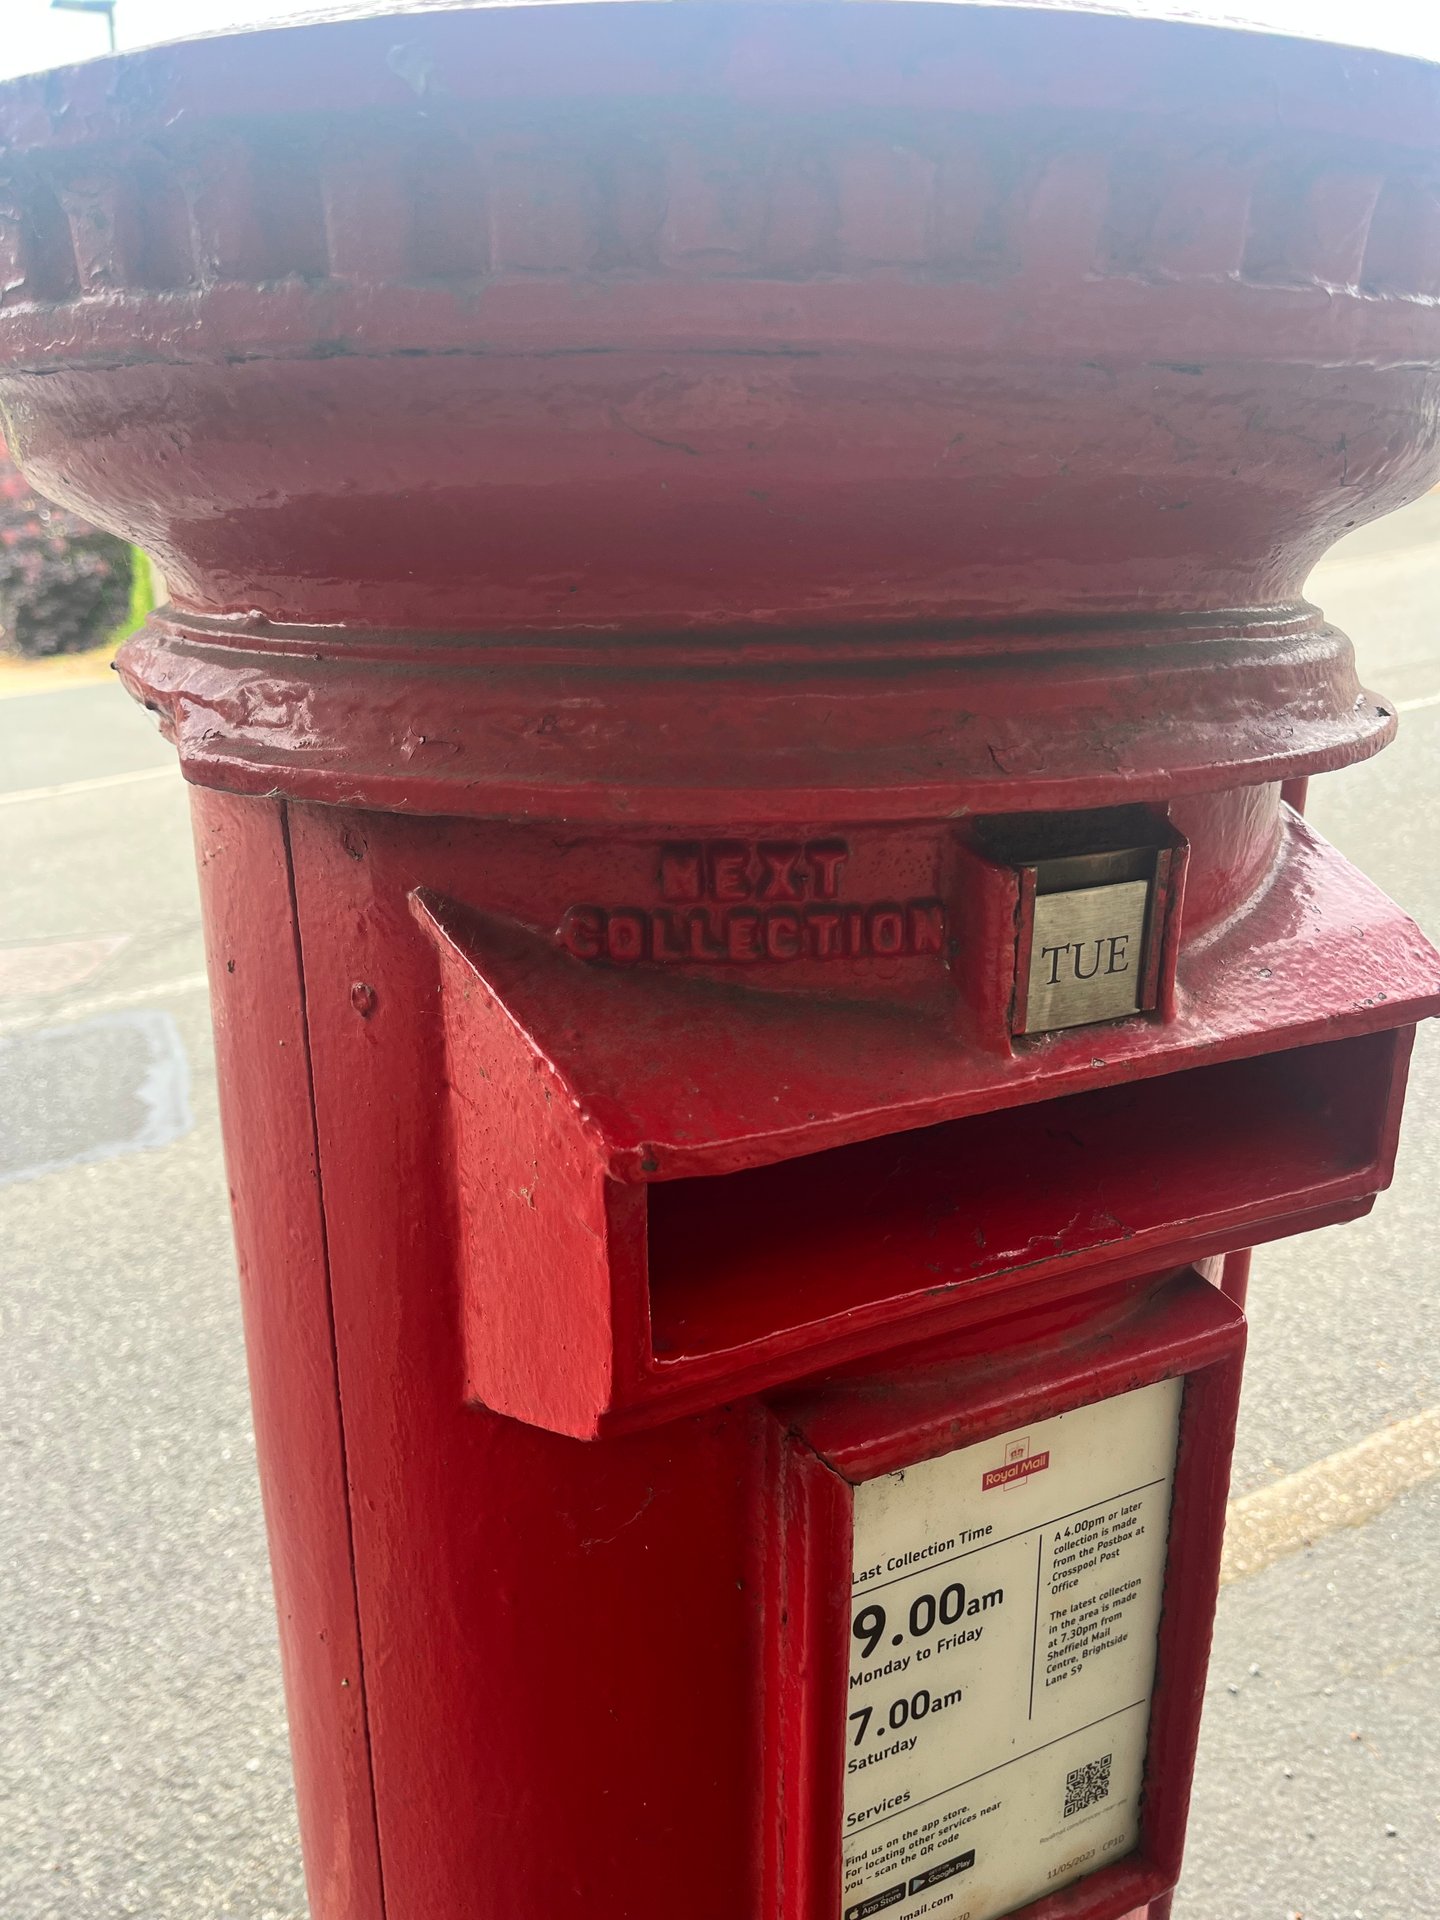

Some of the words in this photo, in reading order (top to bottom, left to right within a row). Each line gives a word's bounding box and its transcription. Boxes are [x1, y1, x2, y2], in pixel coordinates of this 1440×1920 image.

[661, 841, 849, 899] NEXT
[564, 904, 944, 960] COLLECTION
[1042, 934, 1130, 985] TUE
[986, 1465, 1018, 1485] Royal
[1021, 1454, 1046, 1472] Mail
[1053, 1532, 1098, 1555] collection
[1101, 1527, 1109, 1537] is
[1112, 1517, 1137, 1532] made
[1054, 1531, 1061, 1542] A
[1064, 1515, 1105, 1537] 4.00pm
[1108, 1511, 1118, 1521] or
[1121, 1501, 1143, 1516] later
[852, 1564, 882, 1585] Last
[887, 1539, 954, 1571] Collection
[959, 1524, 993, 1544] Time
[1052, 1556, 1097, 1582] Crosspool
[1100, 1548, 1120, 1563] Post
[1053, 1554, 1076, 1569] from
[1079, 1547, 1094, 1558] the
[1097, 1531, 1133, 1551] Postbox
[1135, 1525, 1145, 1536] at
[1050, 1608, 1068, 1621] The
[1070, 1596, 1097, 1613] latest
[1099, 1578, 1142, 1601] collection
[1051, 1578, 1079, 1595] Office
[852, 1582, 1004, 1659] 9.00am
[1047, 1638, 1058, 1649] at
[1060, 1621, 1098, 1643] 7.30pm
[1100, 1611, 1123, 1626] from
[1048, 1625, 1058, 1635] in
[1060, 1618, 1076, 1630] the
[1078, 1608, 1099, 1622] area
[1101, 1603, 1110, 1612] is
[1112, 1592, 1137, 1608] made
[849, 1656, 910, 1689] Monday
[916, 1648, 931, 1661] to
[937, 1627, 983, 1653] Friday
[1047, 1637, 1089, 1661] Sheffield
[1091, 1627, 1111, 1643] Mail
[1082, 1632, 1128, 1659] Brightside
[1045, 1672, 1068, 1687] Lane
[1070, 1663, 1083, 1676] S9
[849, 1689, 962, 1746] 7.00am
[848, 1736, 917, 1774] Saturday
[847, 1791, 911, 1827] Services
[845, 1850, 868, 1867] Find
[871, 1844, 883, 1856] us
[886, 1837, 899, 1849] on
[902, 1828, 919, 1841] the
[921, 1818, 940, 1832] app
[942, 1805, 970, 1823] store.
[845, 1867, 862, 1880] For
[865, 1846, 906, 1870] locating
[908, 1832, 936, 1850] other
[938, 1813, 977, 1836] services
[980, 1800, 1003, 1817] near
[844, 1878, 863, 1894] you
[874, 1862, 898, 1878] scan
[900, 1853, 917, 1867] the
[920, 1843, 935, 1856] QR
[937, 1832, 960, 1848] code
[928, 1867, 955, 1883] Google
[955, 1859, 971, 1870] Play
[1047, 1848, 1096, 1880] 11/05/2023
[861, 1903, 879, 1916] App
[880, 1892, 902, 1907] Store
